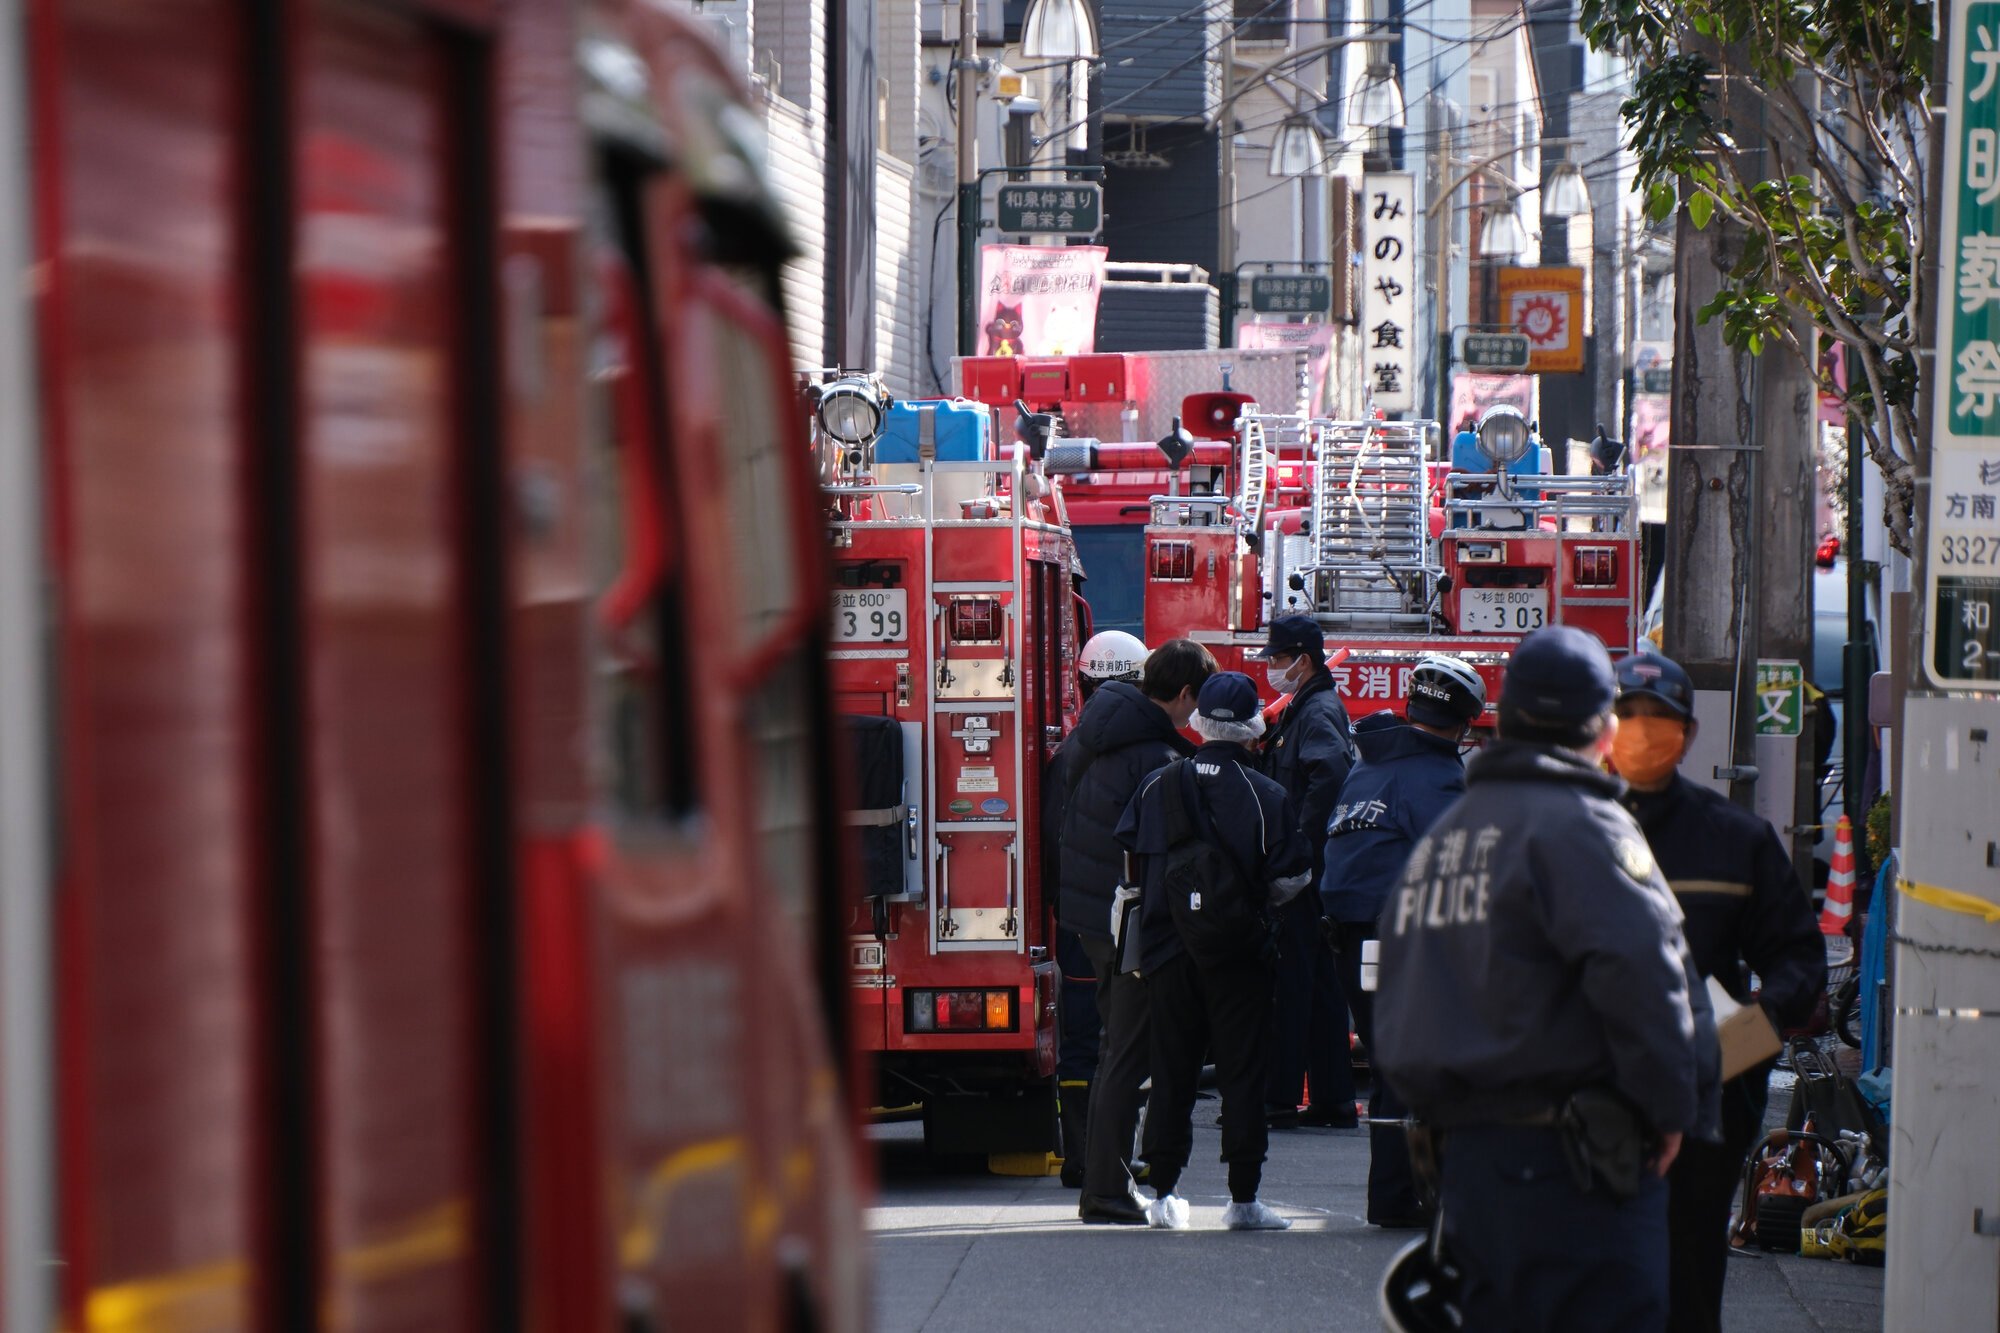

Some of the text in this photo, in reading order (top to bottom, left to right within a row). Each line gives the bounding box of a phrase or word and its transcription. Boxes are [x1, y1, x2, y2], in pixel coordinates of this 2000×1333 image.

[1006, 190, 1091, 208] 和泉仲通り
[1021, 211, 1073, 228] 商栄会
[1372, 191, 1404, 393] みのや食堂
[1945, 493, 1997, 519] 方南
[1962, 601, 1990, 630] 和
[1089, 660, 1131, 672] 東京消防庁
[1417, 684, 1451, 702] POLICE
